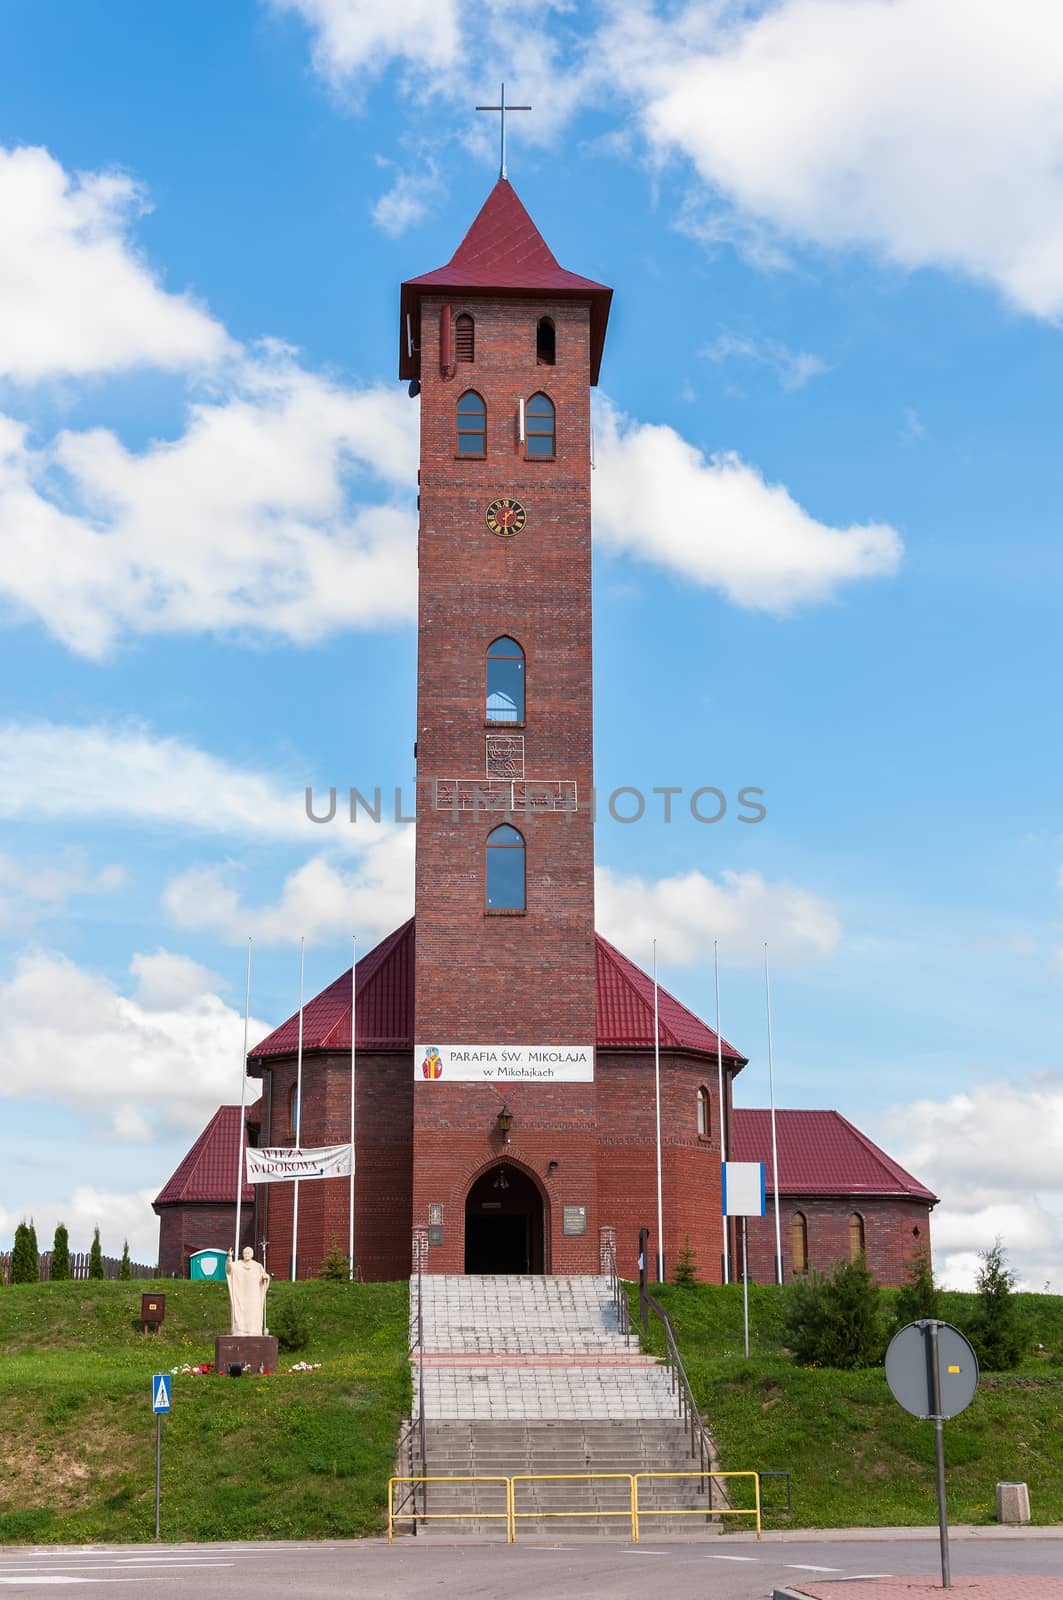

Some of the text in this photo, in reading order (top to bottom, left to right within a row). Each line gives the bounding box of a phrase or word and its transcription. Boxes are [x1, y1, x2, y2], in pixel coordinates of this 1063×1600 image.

[450, 1051, 498, 1062] PARAFIA
[528, 1052, 587, 1063] MIKOŁAJA
[483, 1067, 554, 1078] w Mikołajkach
[250, 1161, 318, 1174] WIDOKOWA
